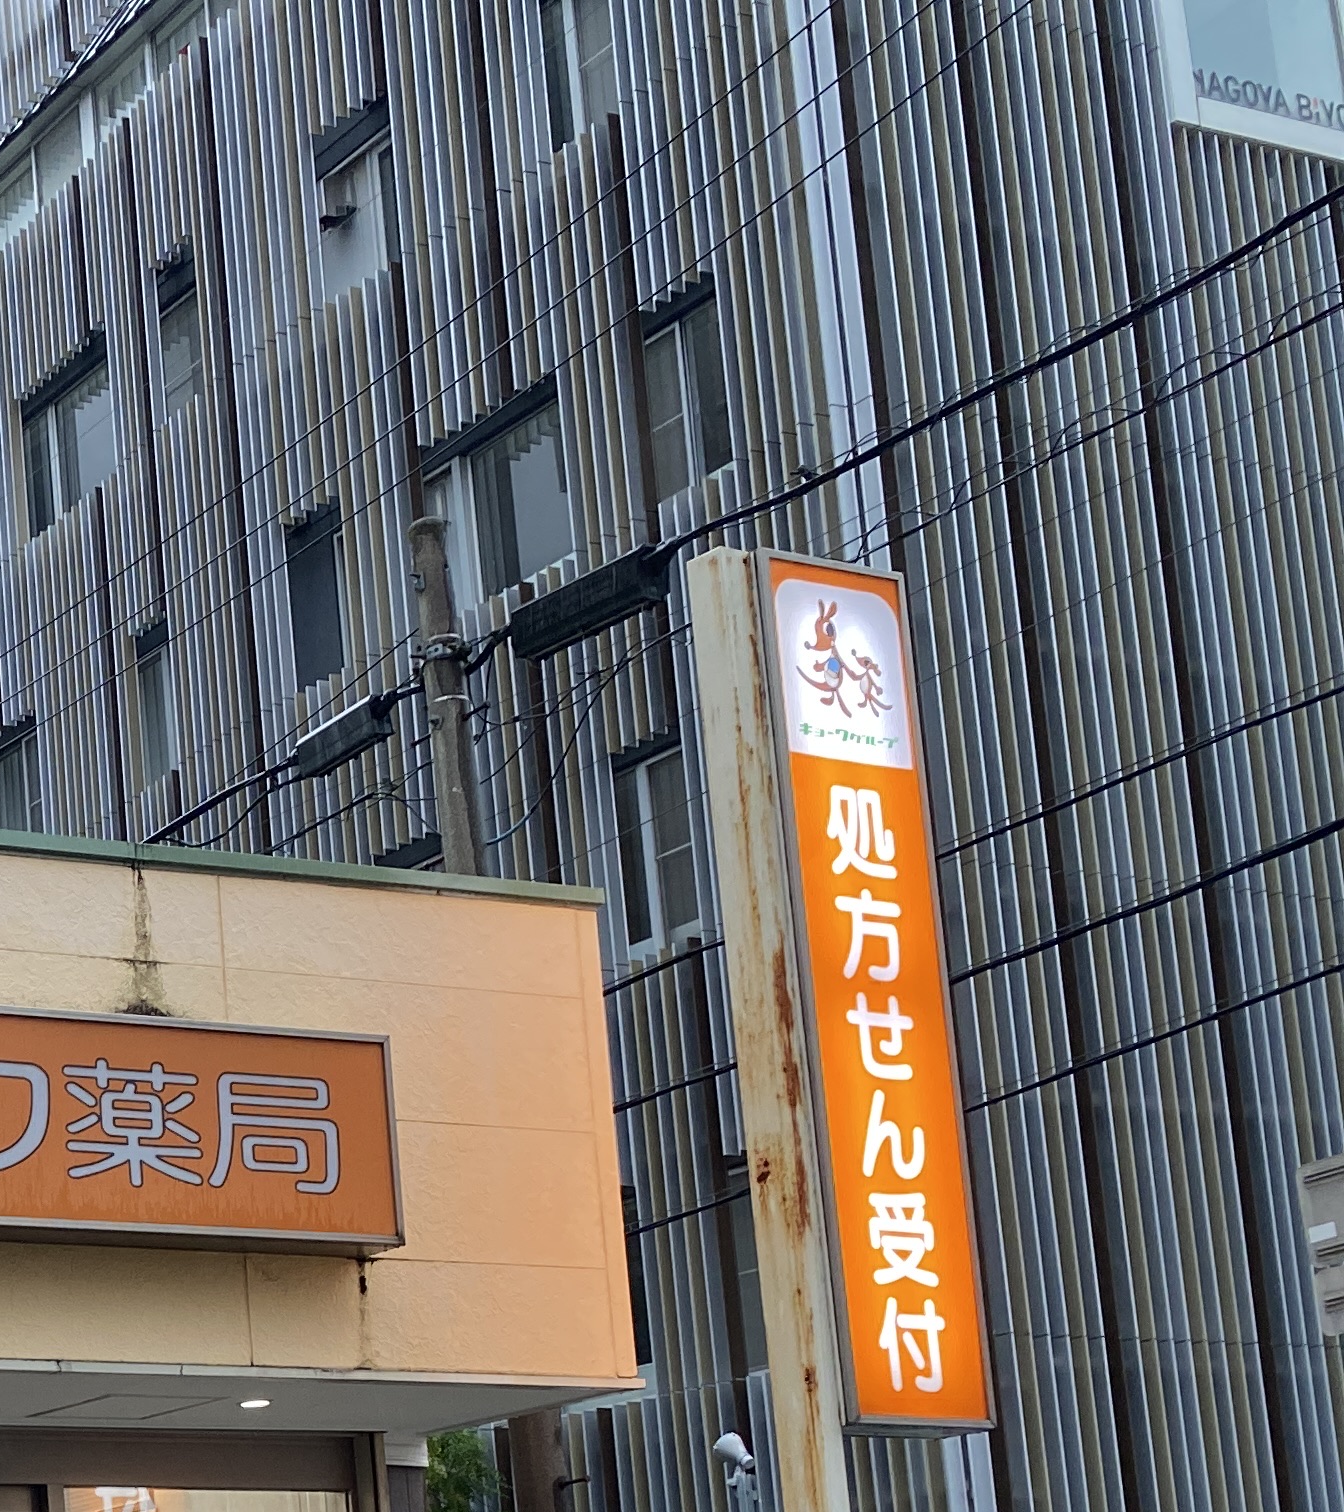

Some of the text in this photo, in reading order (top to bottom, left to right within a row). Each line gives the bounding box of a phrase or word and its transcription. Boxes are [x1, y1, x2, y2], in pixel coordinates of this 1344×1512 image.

[1193, 68, 1290, 115] NAGOYA
[799, 721, 900, 750] キョーワグループ
[826, 784, 945, 1393] 処方せん受付
